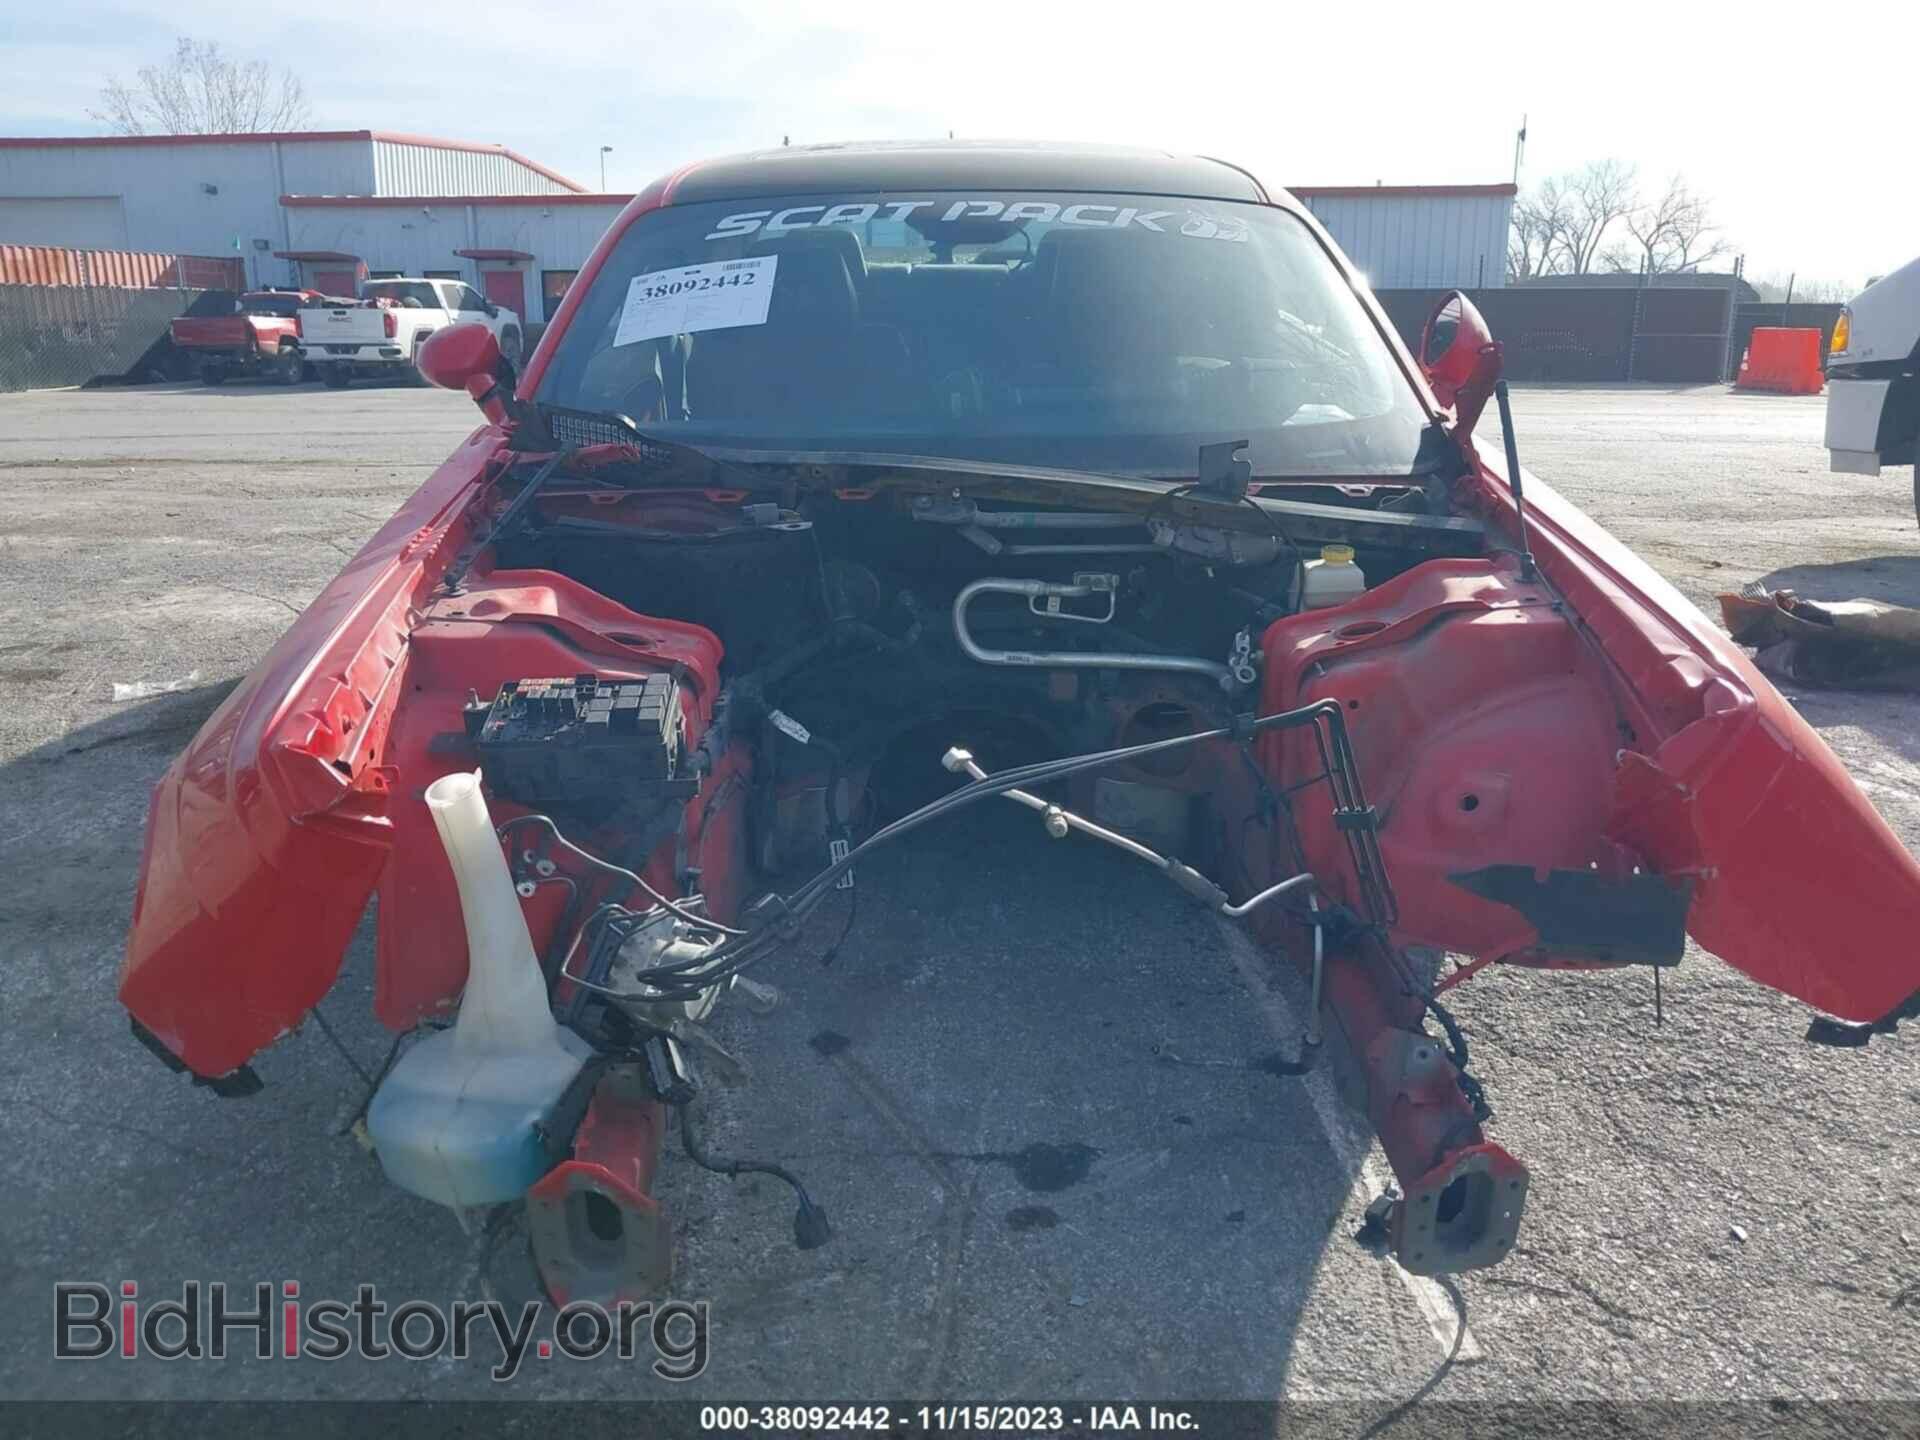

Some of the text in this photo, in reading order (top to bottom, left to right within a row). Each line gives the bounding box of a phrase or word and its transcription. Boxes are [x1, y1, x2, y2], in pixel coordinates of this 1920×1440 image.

[704, 200, 1176, 240] SCAT PACK
[639, 272, 755, 302] 38092442
